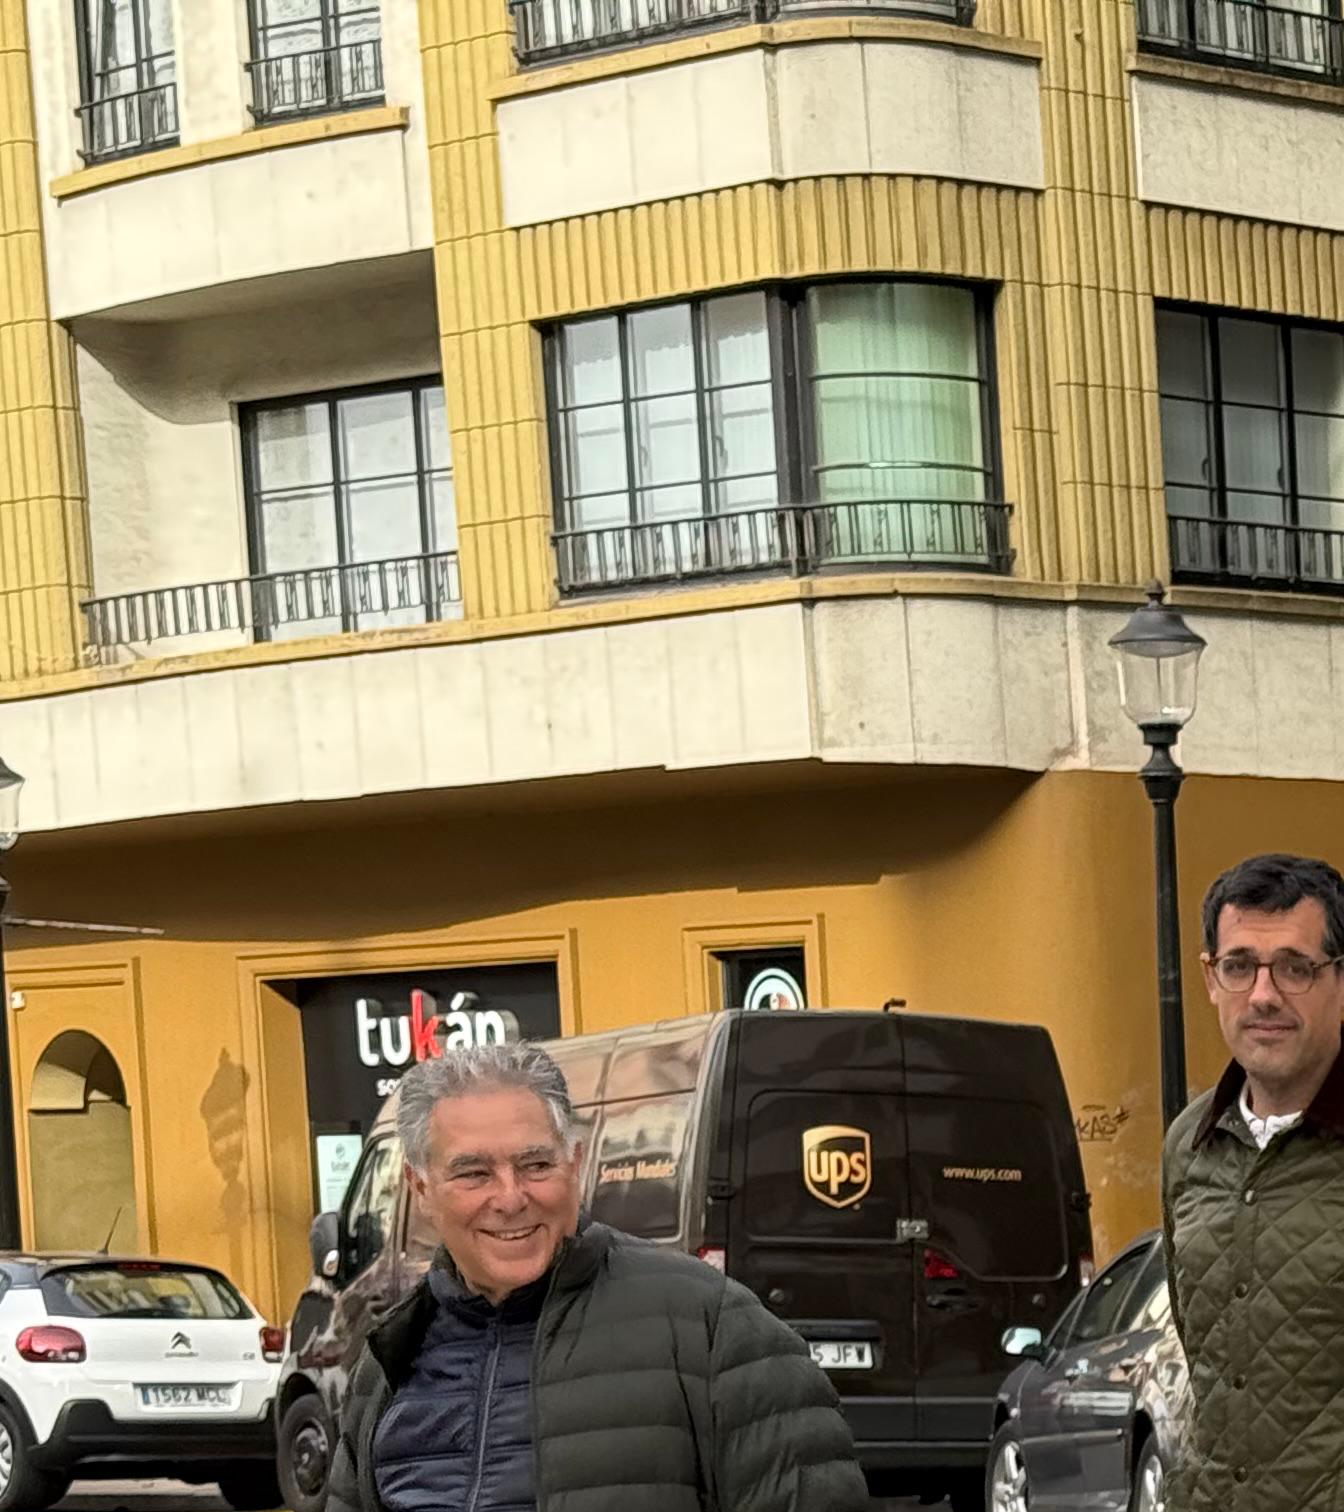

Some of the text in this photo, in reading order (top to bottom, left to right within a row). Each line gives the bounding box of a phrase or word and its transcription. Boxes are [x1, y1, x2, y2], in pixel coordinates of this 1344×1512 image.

[356, 989, 507, 1067] tukán
[809, 1151, 866, 1194] ups
[943, 1166, 1022, 1183] www.ups.com
